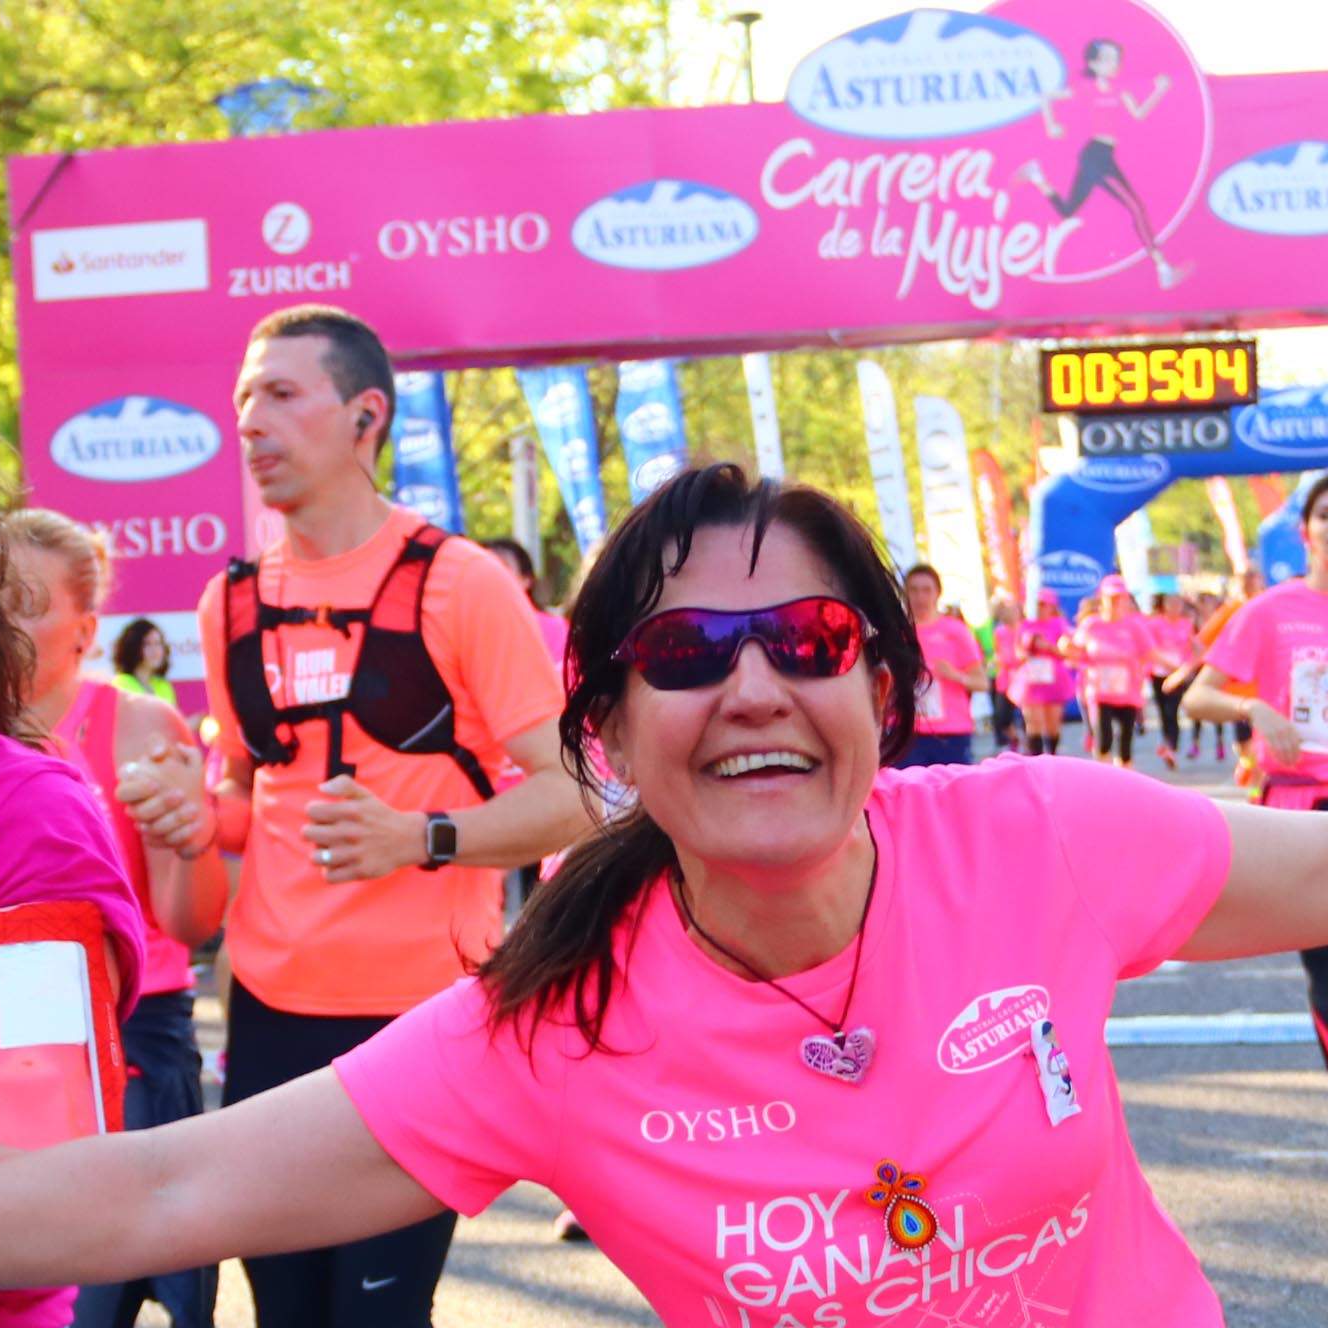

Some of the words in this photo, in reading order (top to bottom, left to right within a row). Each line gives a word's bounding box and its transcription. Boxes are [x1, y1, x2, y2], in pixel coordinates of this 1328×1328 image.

[807, 64, 1043, 111] ASTURIANA
[760, 137, 993, 210] Carrera
[377, 211, 551, 261] OYSHO
[586, 217, 743, 249] ASTURIANA
[818, 210, 862, 259] de
[872, 205, 904, 257] la
[895, 190, 1084, 310] Mujer
[81, 249, 187, 273] Santander
[227, 261, 351, 298] ZURICH
[66, 432, 207, 466] ASTURIANA
[1082, 415, 1230, 455] OYSHO
[94, 511, 227, 558] YSHO
[948, 1000, 1046, 1068] ASTURIANA
[640, 1100, 797, 1144] OYSHO
[716, 1188, 851, 1259] HOY
[865, 1192, 1091, 1318] CHICAS
